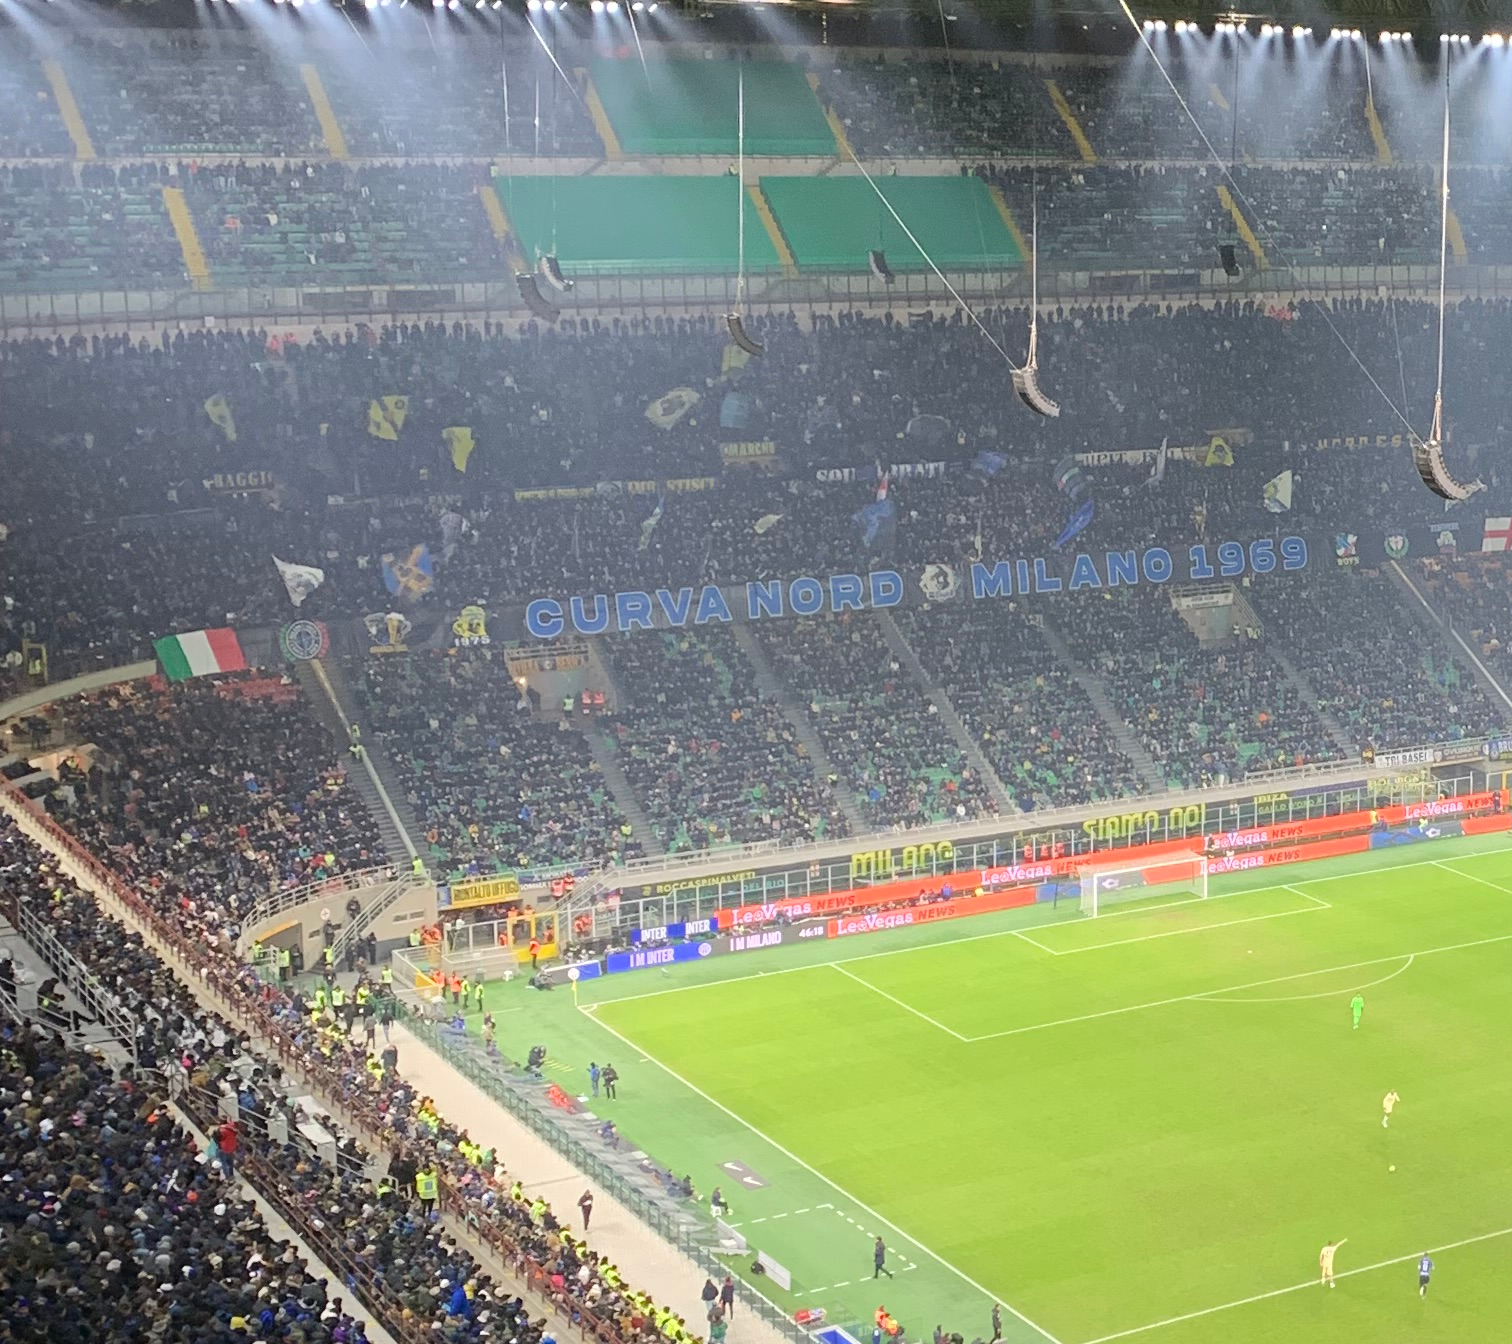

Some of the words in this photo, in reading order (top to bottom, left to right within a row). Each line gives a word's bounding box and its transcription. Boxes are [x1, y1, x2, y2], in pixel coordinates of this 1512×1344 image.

[971, 547, 1173, 599] MILANO
[1189, 536, 1308, 579] 1969
[1336, 557, 1360, 566] BOYS
[525, 586, 732, 639] CURVA
[746, 570, 904, 619] NORD
[454, 635, 491, 647] 1975
[1253, 792, 1288, 804] IBIZA
[1404, 800, 1464, 819] LeoVegas
[1466, 796, 1495, 810] NEWS
[1272, 826, 1304, 839] NEWS
[1268, 850, 1301, 864] NEWS
[981, 863, 1051, 886] LeoVegas
[1057, 859, 1092, 874] NEWS
[731, 903, 812, 925] LeoVegas
[816, 895, 856, 911] NEWS
[836, 911, 913, 935] LeoVegas
[918, 906, 956, 921] NEWS
[640, 926, 667, 942] INTER
[685, 919, 711, 935] INTER
[798, 926, 824, 938] 46:18
[746, 931, 782, 950] MILANO
[646, 948, 675, 965] INTER
